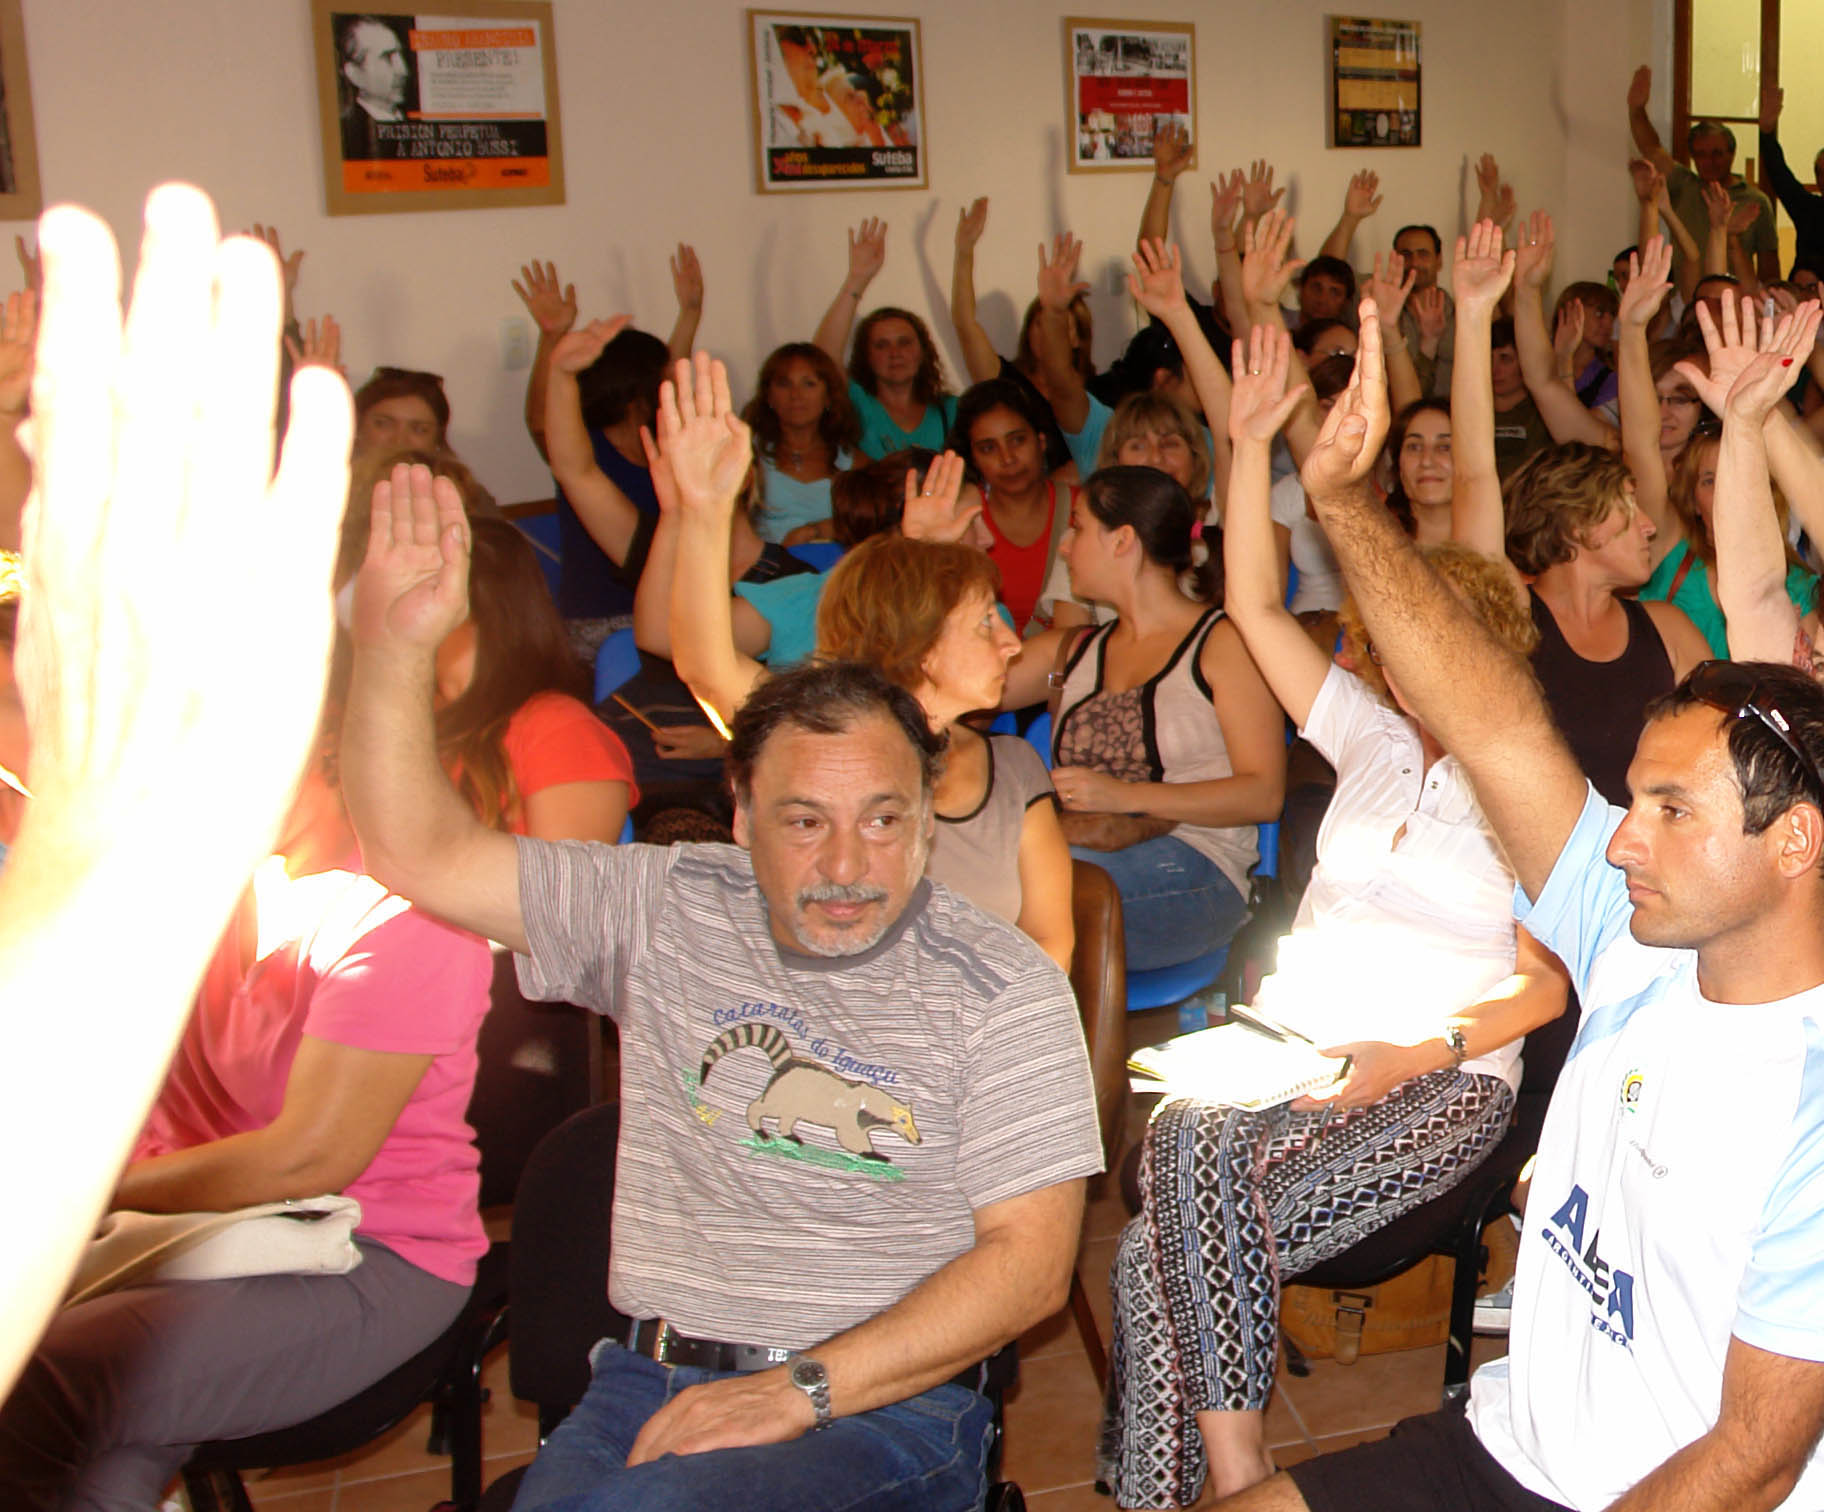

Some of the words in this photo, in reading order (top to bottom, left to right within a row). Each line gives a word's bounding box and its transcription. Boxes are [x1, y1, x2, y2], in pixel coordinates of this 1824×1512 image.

[396, 141, 406, 157] A
[410, 140, 473, 158] ANTONIO
[871, 150, 913, 166] Suteba
[712, 1001, 809, 1041] Cataratas
[831, 1047, 901, 1086] Iguaçu
